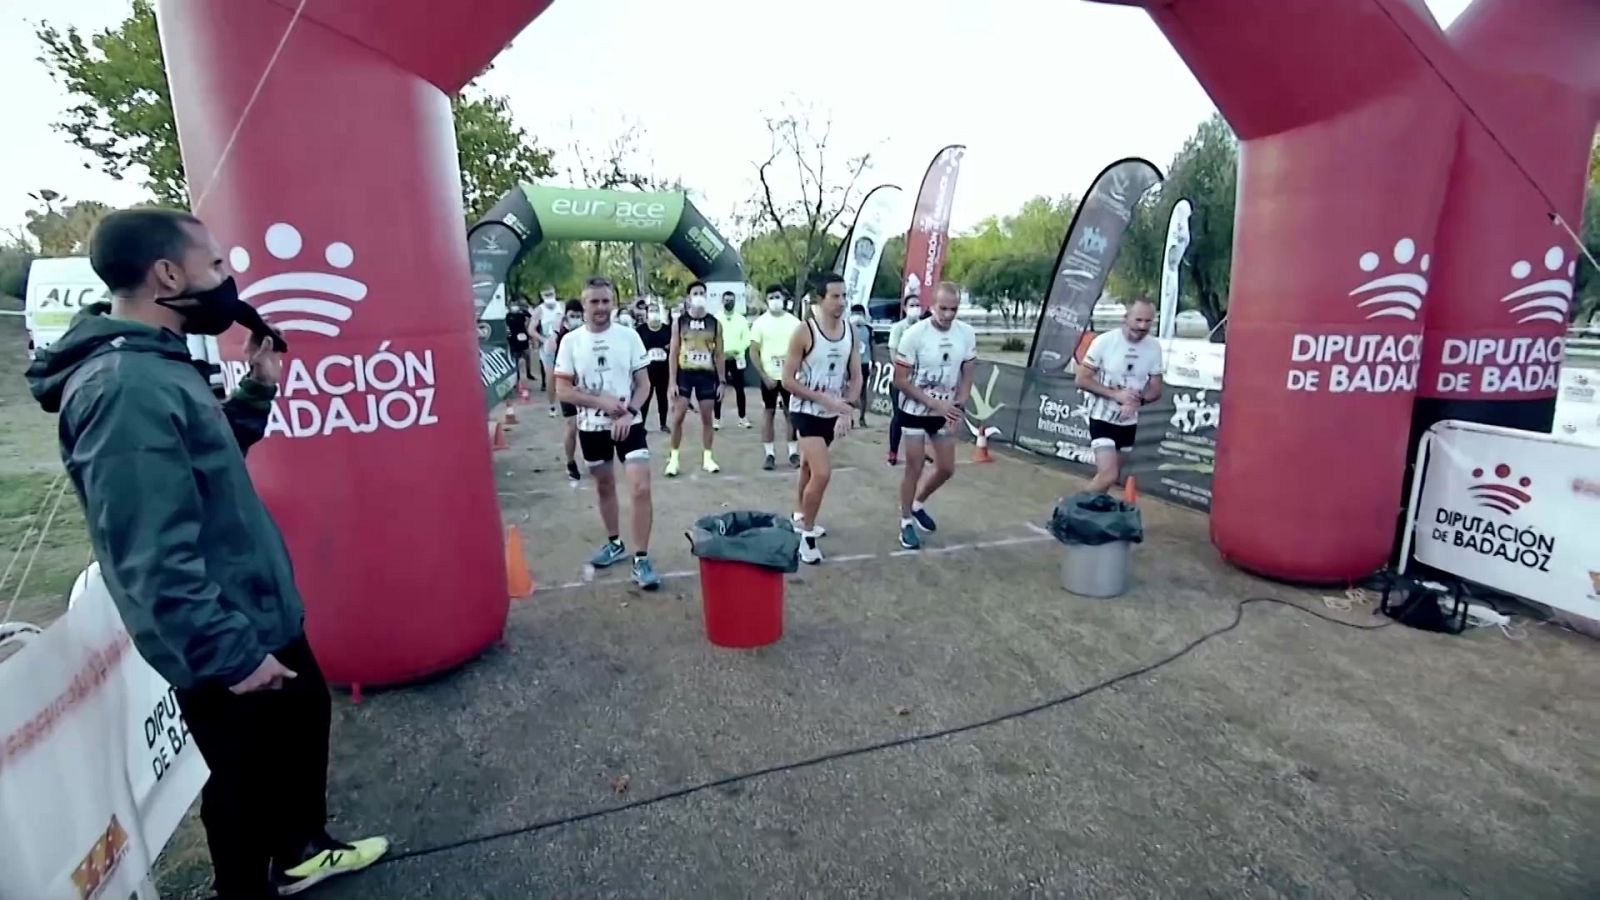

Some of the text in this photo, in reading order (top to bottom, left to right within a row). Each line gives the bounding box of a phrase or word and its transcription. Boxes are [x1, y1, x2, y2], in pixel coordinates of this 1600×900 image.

[1286, 369, 1320, 391] DE
[1436, 372, 1471, 392] DE
[264, 387, 439, 438] ADAJOZ
[1435, 507, 1555, 553] DIPUTACIÓN
[1431, 528, 1551, 572] DE BADAJOZ
[153, 747, 171, 781] DE
